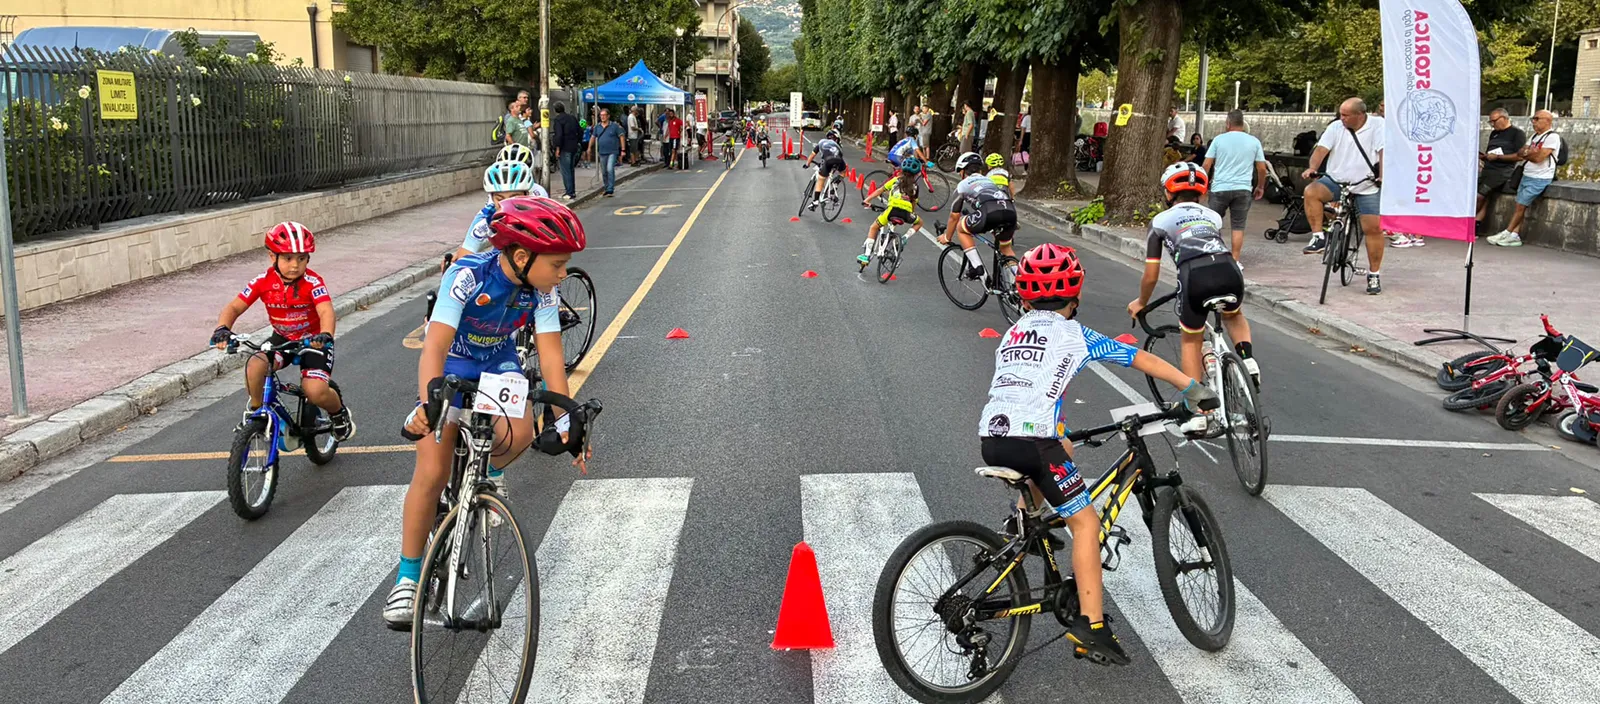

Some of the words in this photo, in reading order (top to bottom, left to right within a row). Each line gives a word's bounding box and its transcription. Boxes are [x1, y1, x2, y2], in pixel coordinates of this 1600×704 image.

[102, 77, 113, 85] ZONA
[114, 78, 132, 86] MILITARE
[110, 89, 127, 99] LIMITE
[103, 103, 135, 112] INVALICABILE
[498, 387, 510, 403] 6
[1058, 471, 1082, 492] PETRO
